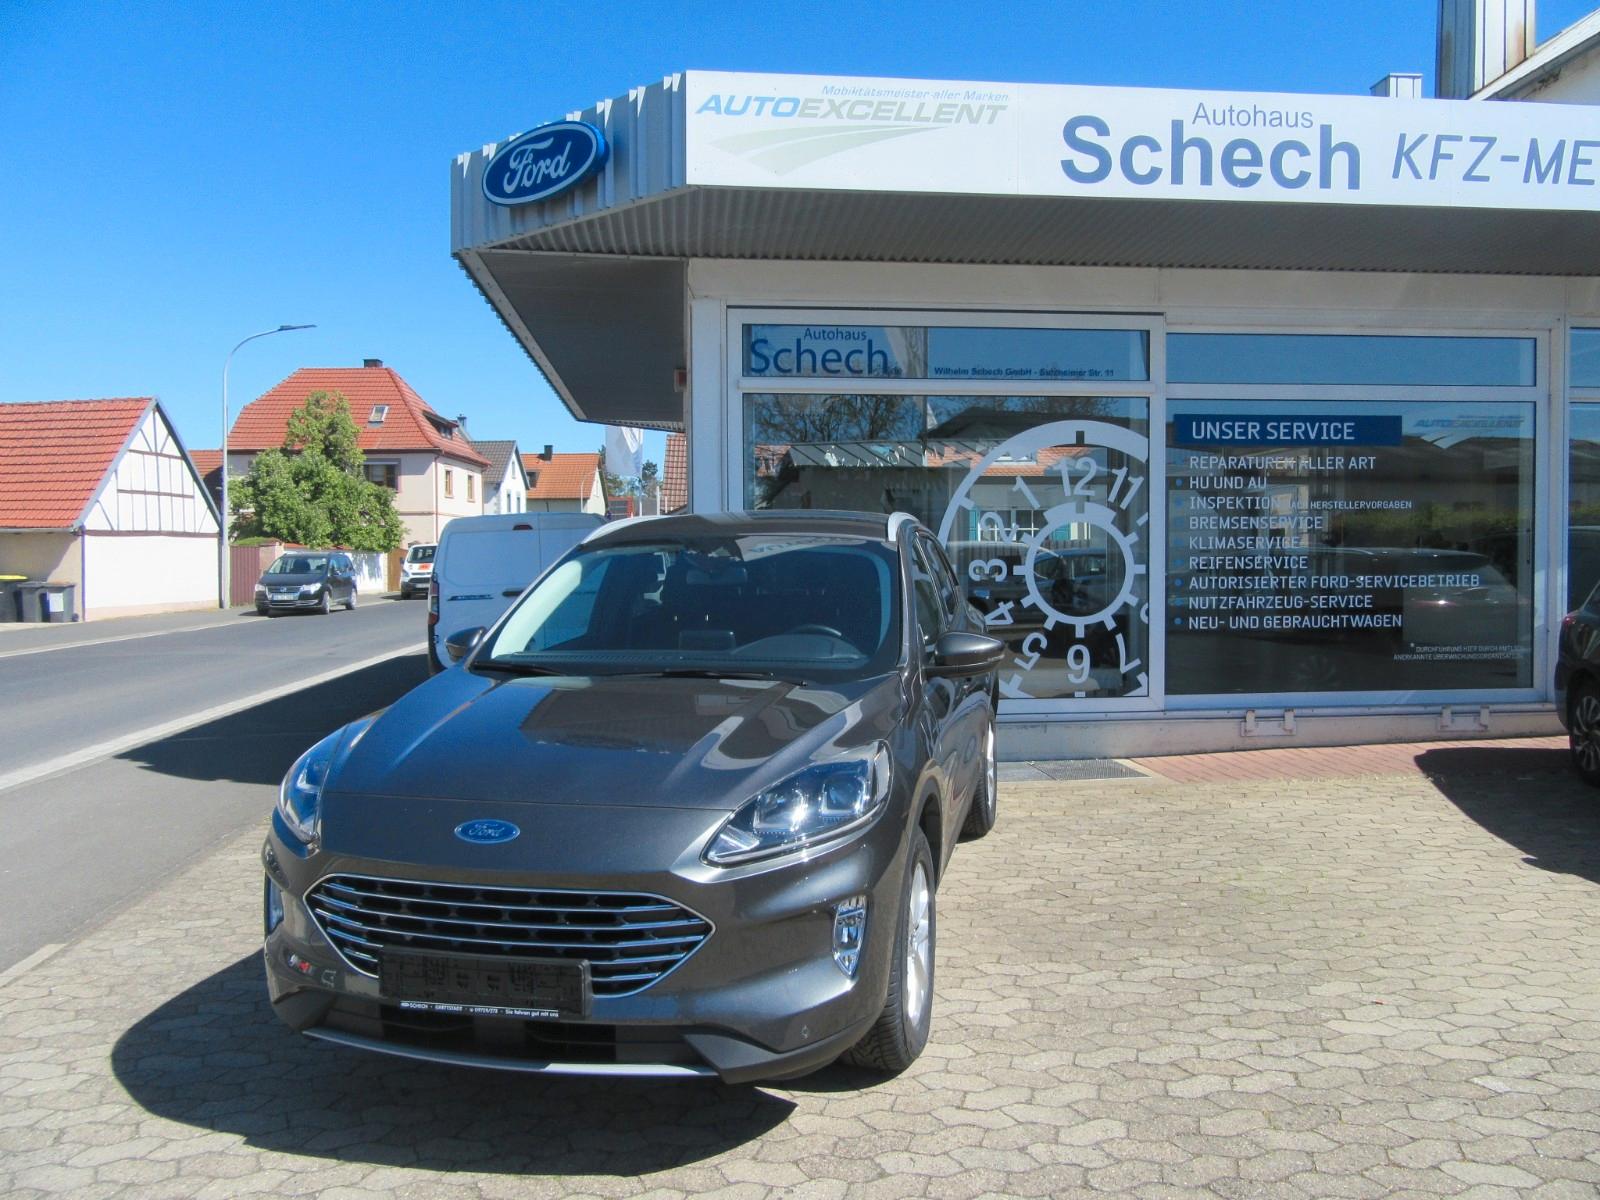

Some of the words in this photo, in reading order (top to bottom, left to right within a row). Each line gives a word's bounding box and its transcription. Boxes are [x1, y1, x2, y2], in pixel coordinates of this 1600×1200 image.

[932, 89, 961, 100] aller
[963, 90, 1009, 102] Marken
[695, 94, 1009, 126] AUTOEXCELLENT
[1192, 102, 1314, 129] Autohaus
[1060, 115, 1361, 191] Schech
[1392, 132, 1600, 187] KFZ-ME
[503, 137, 572, 194] Ford
[804, 327, 867, 341] Autohaus
[750, 338, 889, 375] Schech
[1191, 422, 1260, 440] UNSER
[1266, 422, 1356, 440] SERVICE
[1189, 456, 1298, 470] REPARATUREN
[1300, 456, 1344, 470] ALLER
[1348, 456, 1377, 470] ART
[1057, 456, 1098, 497] 12
[1213, 476, 1244, 489] UND
[1189, 496, 1283, 510] INSPEKTION
[1310, 501, 1412, 510] HERSTELLERVORGABEN
[979, 511, 1020, 544] 2
[1189, 516, 1323, 530] BREMSENSERVICE
[1189, 536, 1302, 550] KLIMASERVICE
[968, 558, 1008, 582] 3
[1189, 556, 1309, 570] REIFENSERVICE
[1189, 576, 1307, 590] AUTORISIERTER
[1311, 574, 1480, 590] FORD-SERVICEBETRIEB
[1189, 595, 1373, 610] NUTZFAHRZEUG-SERVICE
[984, 600, 1015, 626] 4
[1188, 615, 1225, 630] NEU-
[1229, 615, 1259, 630] UND
[1263, 614, 1402, 629] GEBRAUCHTWAGEN
[1115, 632, 1142, 675] 7
